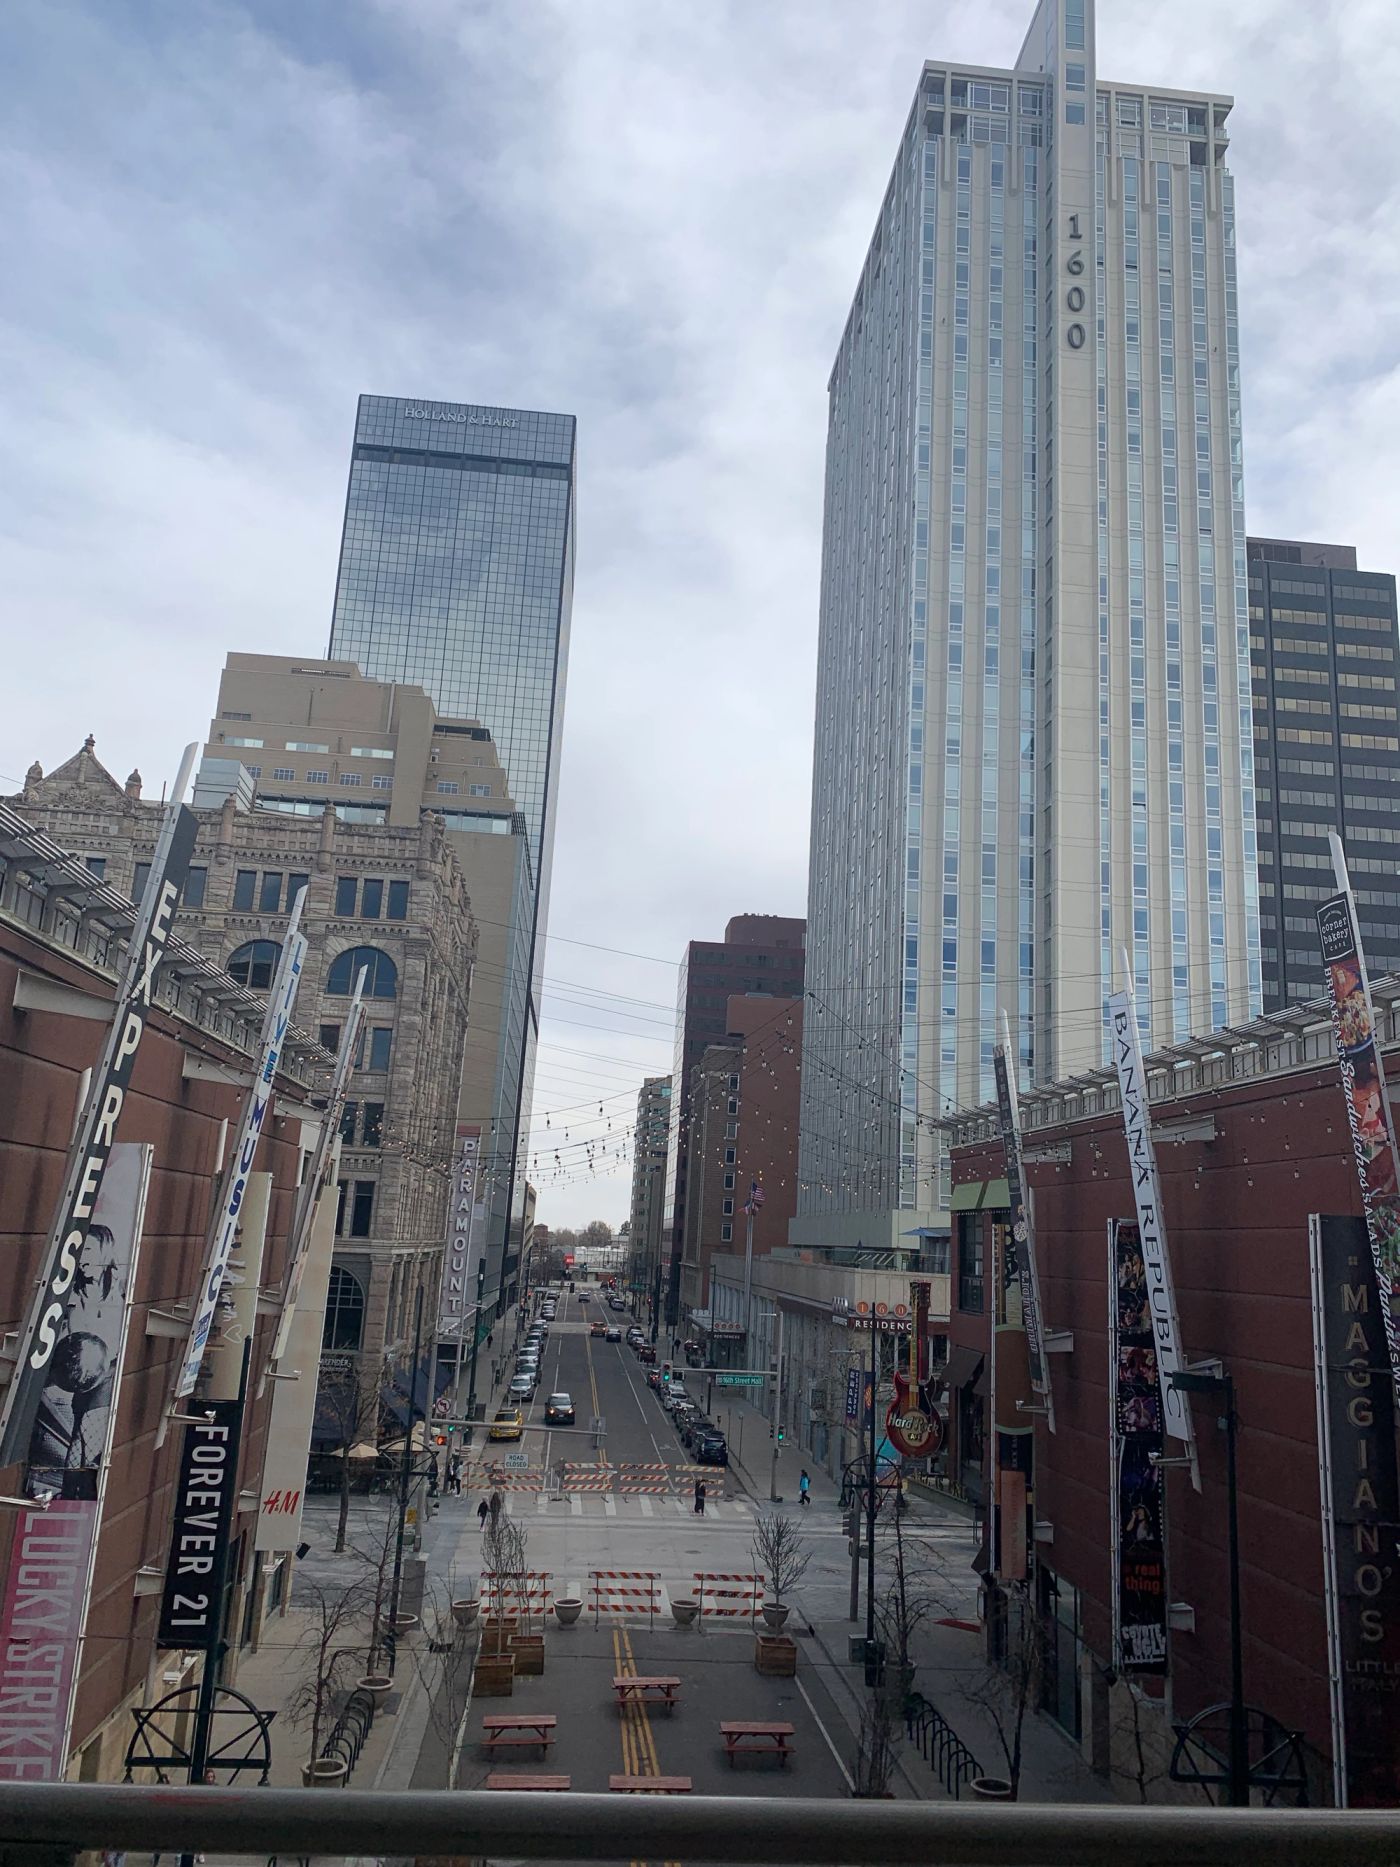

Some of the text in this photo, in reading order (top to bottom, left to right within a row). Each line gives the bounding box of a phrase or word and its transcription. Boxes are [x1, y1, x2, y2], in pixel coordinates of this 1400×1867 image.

[1067, 213, 1086, 349] 1600
[404, 407, 519, 428] HOLLAND & HART
[1321, 916, 1347, 934] corner
[1323, 927, 1349, 945] bakery
[30, 879, 178, 1370] EXPRESS
[207, 936, 302, 1302] LIVE MUSIC
[1323, 966, 1346, 1058] BREAKFAST
[1339, 1059, 1370, 1189] Sandwiches
[1361, 1192, 1383, 1268] SALADS
[449, 1140, 476, 1313] PARAMOUNT
[1113, 1011, 1183, 1418] BANANA REPUBLIC
[855, 1320, 912, 1331] RESIDENC
[734, 1376, 750, 1385] Street
[847, 1371, 856, 1414] UPPER
[888, 1412, 913, 1430] Hard
[177, 1425, 229, 1574] FOREVER
[263, 1490, 301, 1515] H&M
[1342, 1283, 1391, 1642] MAGGIANO'S
[0, 1512, 89, 1779] LUCKY STRIKE
[171, 1598, 209, 1627] 21
